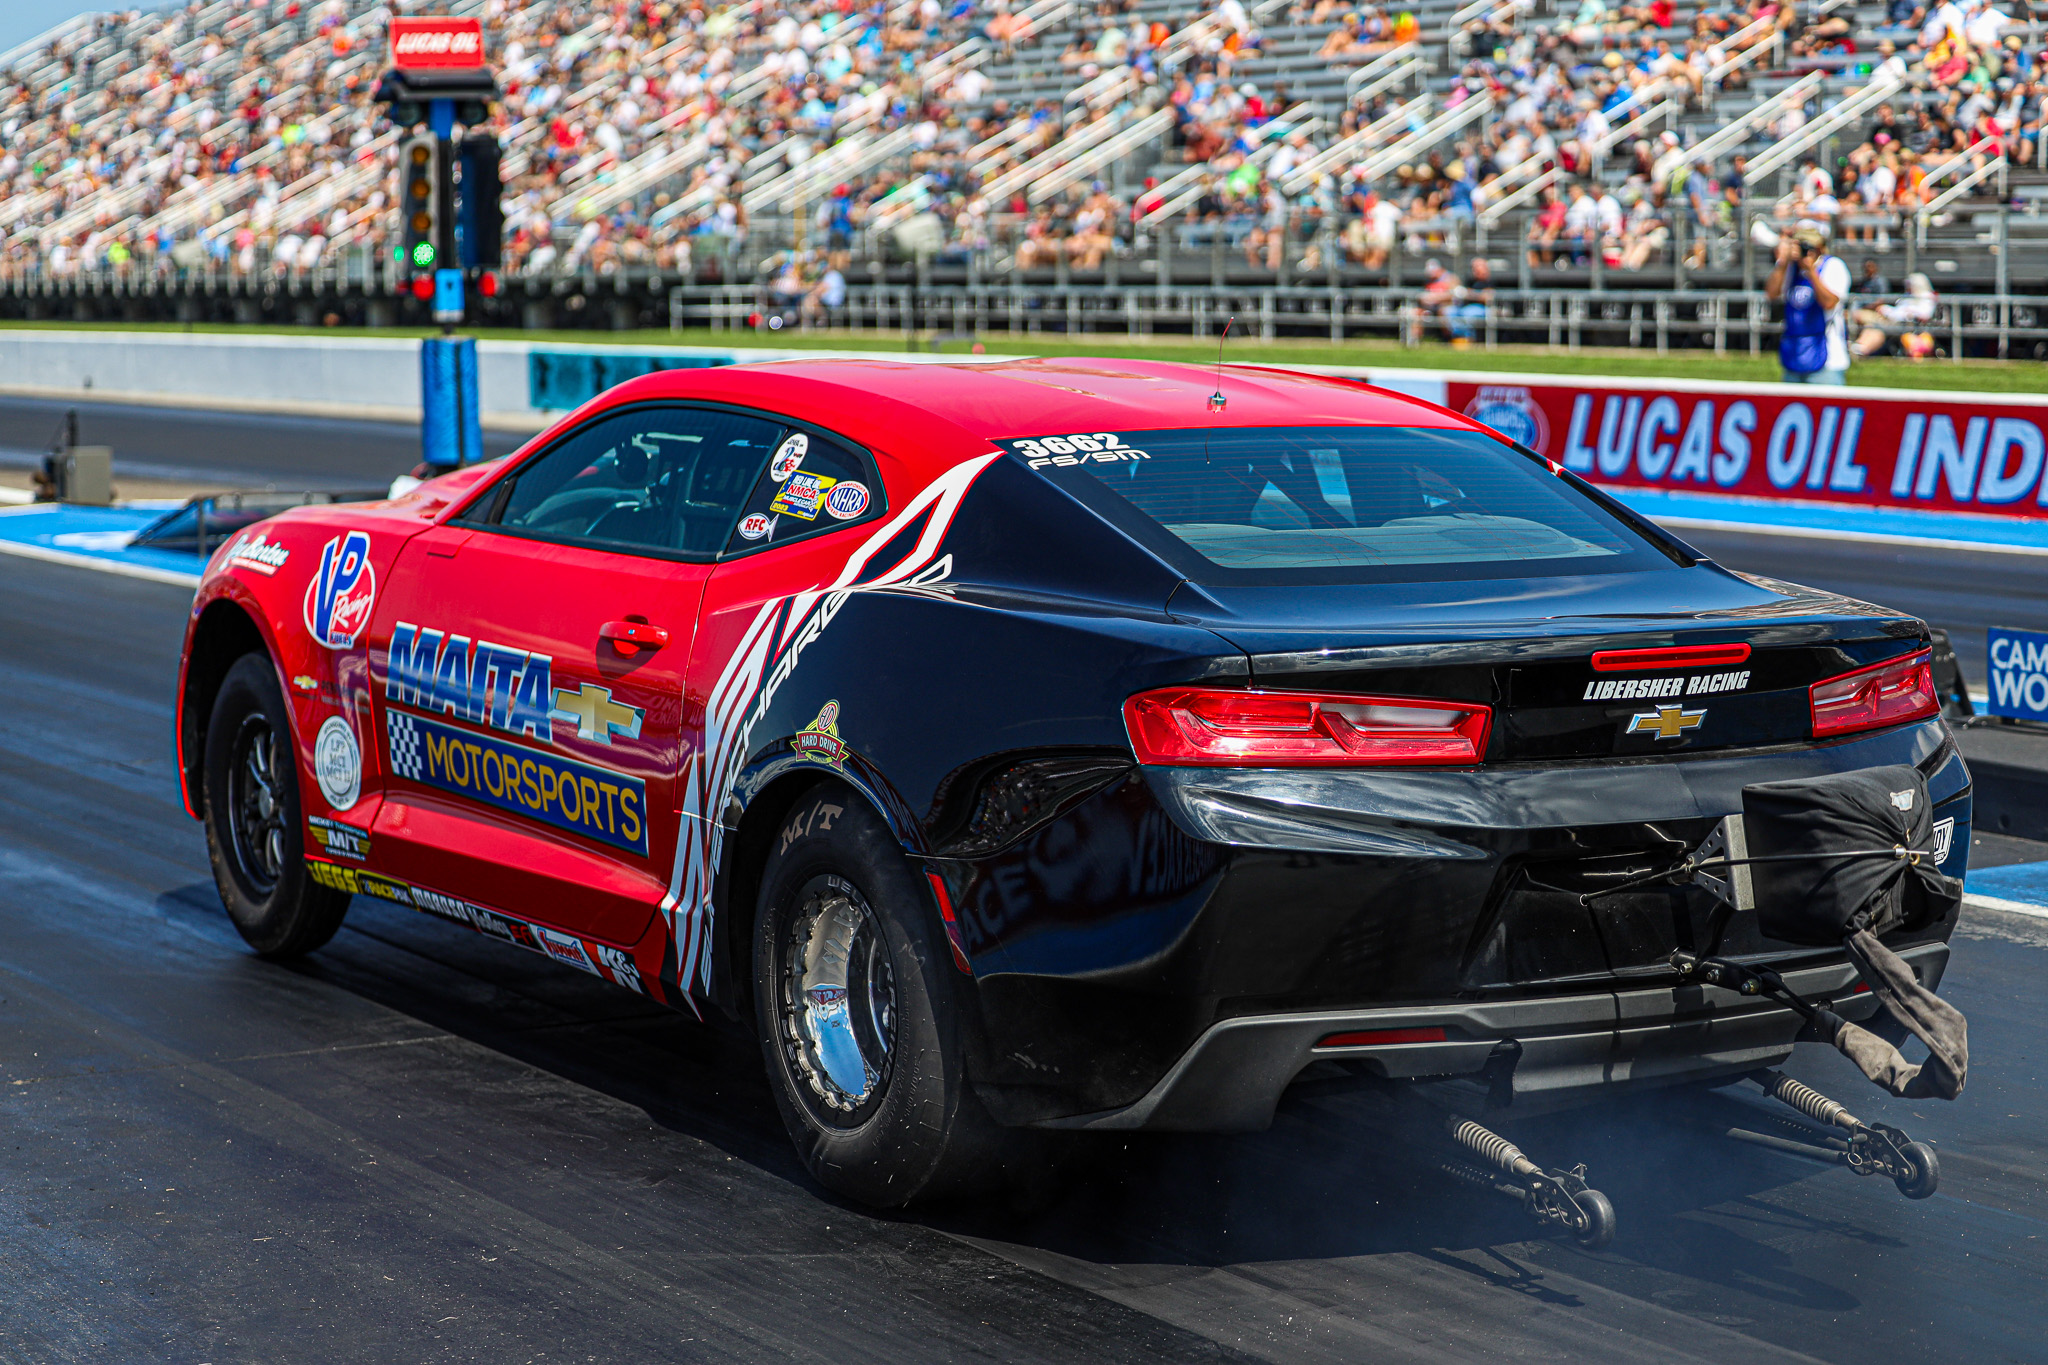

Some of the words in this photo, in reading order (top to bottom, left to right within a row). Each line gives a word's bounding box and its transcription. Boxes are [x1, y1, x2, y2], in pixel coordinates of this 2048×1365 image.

[396, 32, 454, 54] LUCAS
[450, 32, 479, 54] OIL
[1012, 432, 1131, 458] 3662
[1562, 393, 1758, 488] LUCAS
[1766, 401, 1868, 493] OIL
[786, 484, 817, 500] NMCA
[831, 488, 863, 512] NHRA
[744, 518, 767, 531] RFC
[314, 532, 369, 645] VP
[331, 592, 372, 629] Racing
[385, 620, 553, 744] MAITA
[1582, 677, 1685, 701] LIBERSHER
[1685, 670, 1751, 695] RACING
[801, 735, 818, 748] HARD
[819, 736, 838, 755] DRIVE
[426, 731, 642, 842] MOTORSPORTS
[326, 829, 361, 852] M/T
[779, 799, 844, 856] M/T
[311, 861, 359, 895] JEGS
[410, 886, 471, 922] MOROSO
[827, 875, 872, 918] WELD
[596, 943, 645, 995] K&N
[882, 961, 898, 1083] RACING
